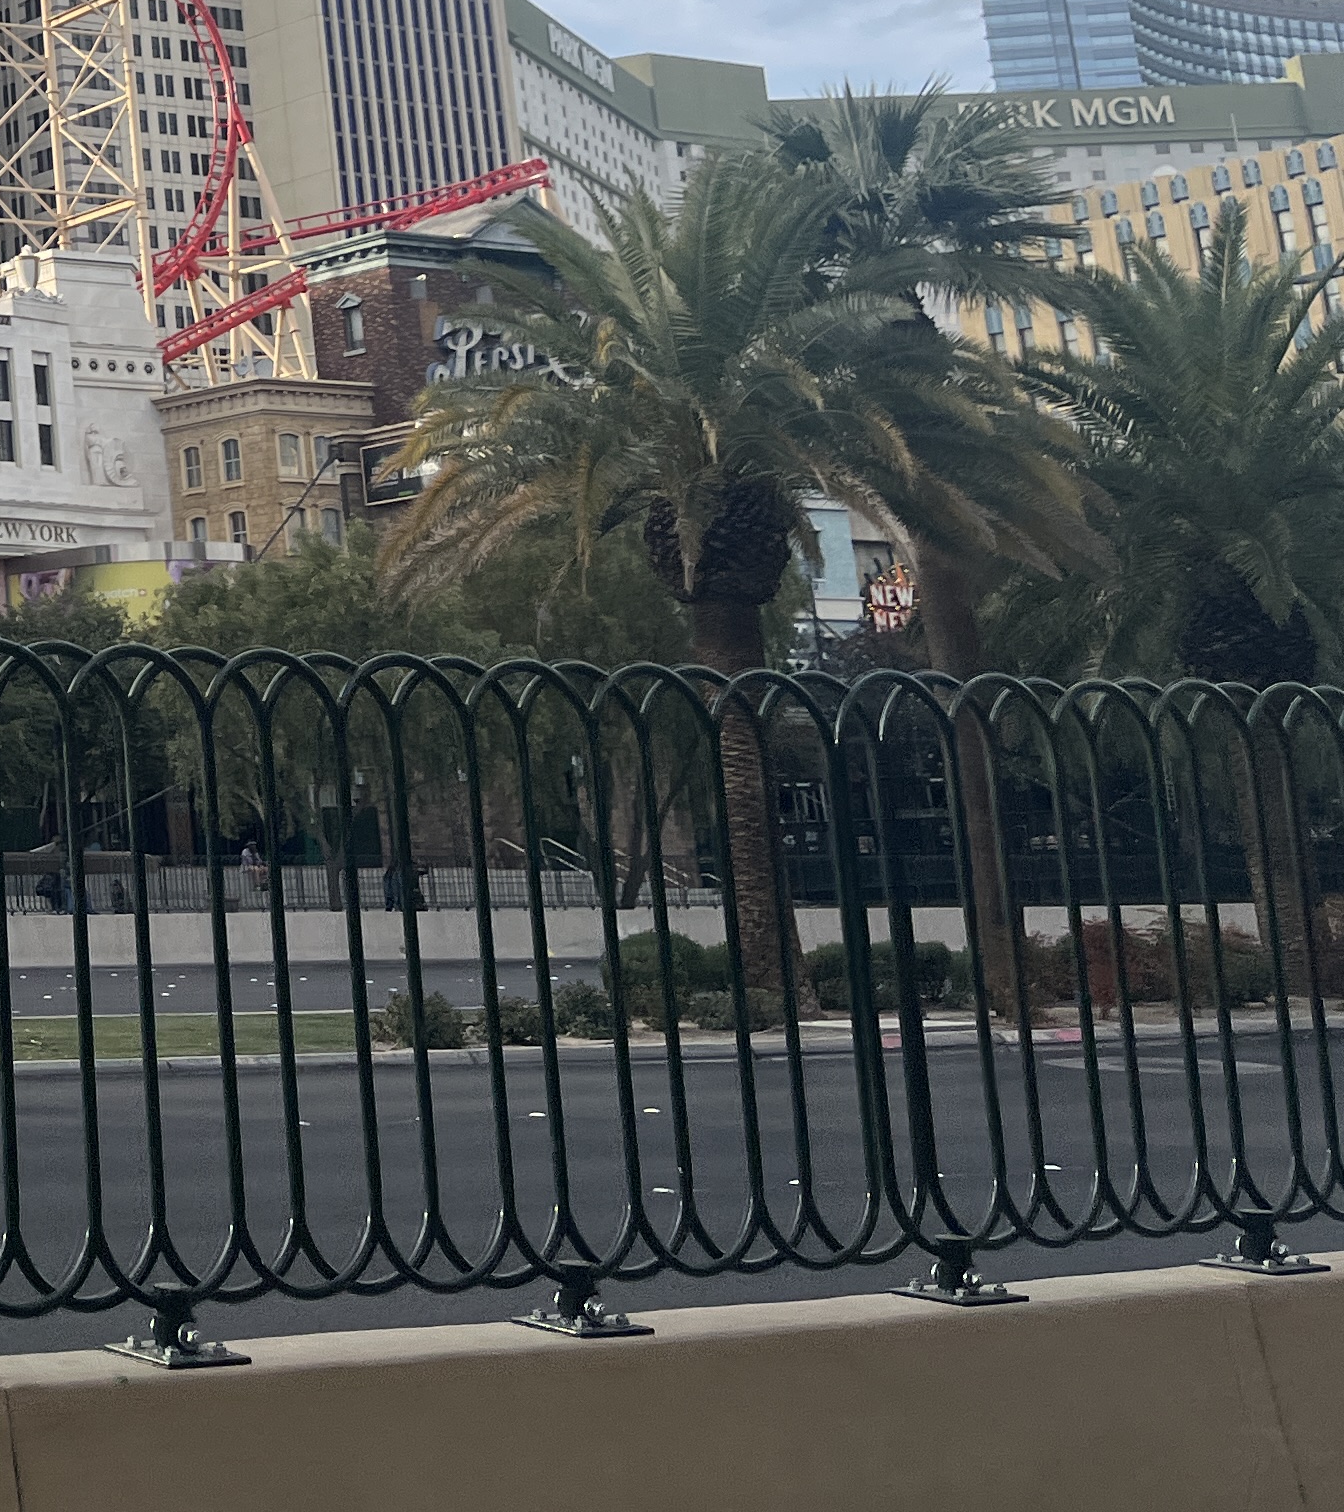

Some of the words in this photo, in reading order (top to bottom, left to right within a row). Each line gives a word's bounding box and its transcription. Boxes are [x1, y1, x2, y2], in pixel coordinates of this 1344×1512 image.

[582, 46, 615, 93] MGM
[1071, 94, 1176, 128] MGM
[27, 523, 78, 544] YORK
[870, 584, 914, 607] NEW
